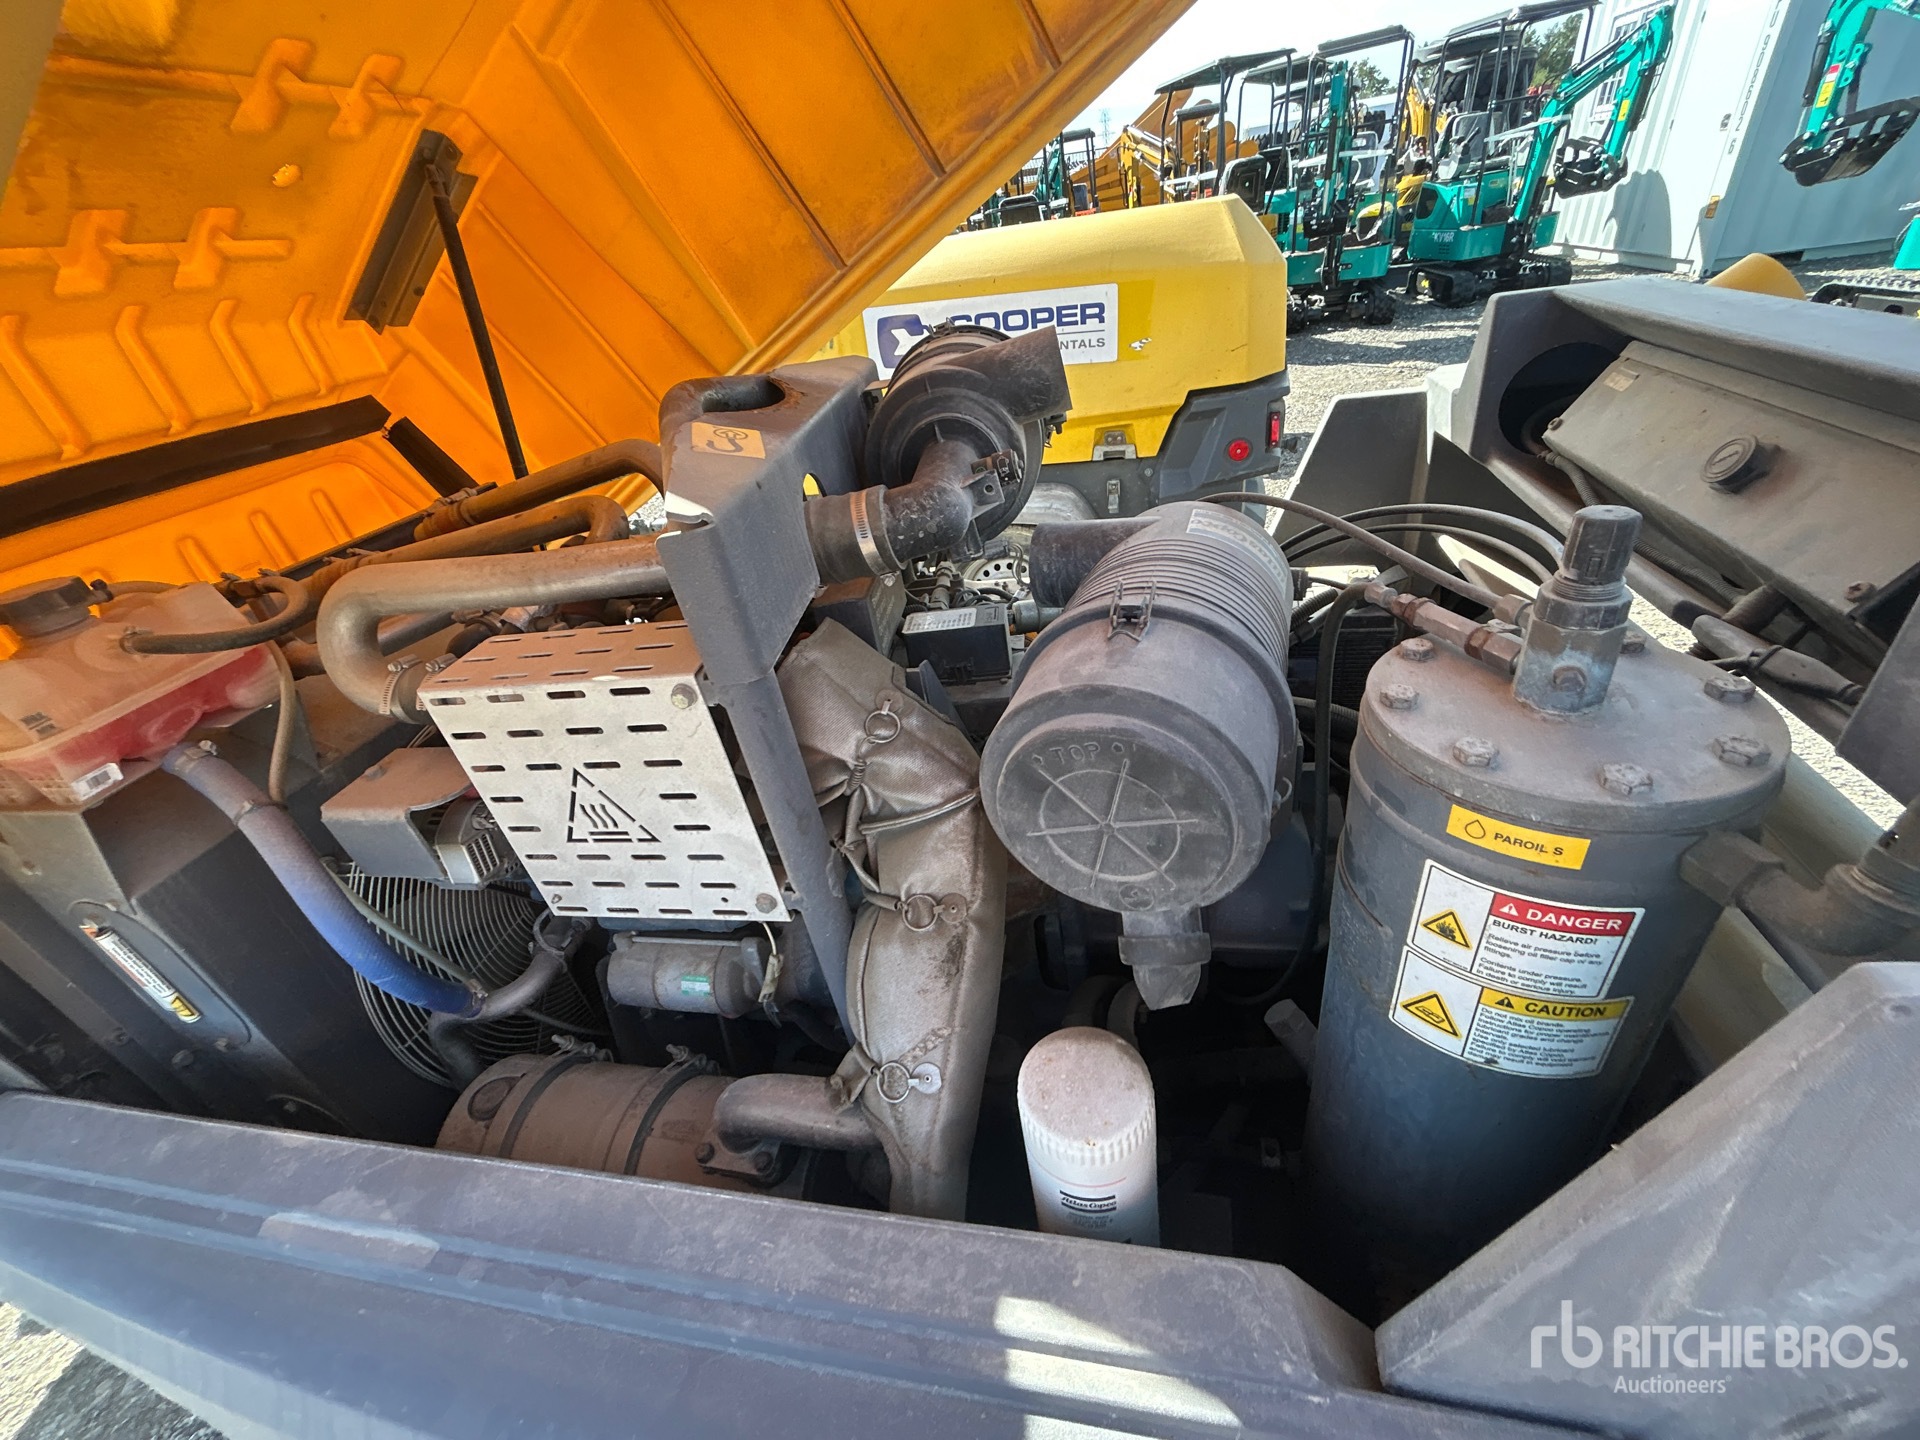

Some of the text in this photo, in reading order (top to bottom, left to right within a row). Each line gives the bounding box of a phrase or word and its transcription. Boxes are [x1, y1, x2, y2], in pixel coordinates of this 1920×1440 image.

[1060, 337, 1106, 351] NTALS
[1050, 741, 1101, 766] TOP
[1493, 832, 1564, 856] PAROIL S
[1525, 907, 1623, 931] DANGER
[1492, 919, 1598, 945] BURST HAZARD!
[1486, 940, 1525, 956] loosening
[1488, 933, 1519, 946] Relieve
[1533, 946, 1572, 957] pressure
[1573, 951, 1601, 959] before
[1478, 962, 1506, 976] Failure
[1517, 975, 1547, 985] comply
[1480, 957, 1516, 972] Contents
[1518, 968, 1543, 977] under
[1485, 971, 1508, 982] death
[1520, 982, 1550, 992] serious
[1480, 1013, 1505, 1023] Follow
[1481, 1007, 1493, 1015] Do
[1525, 1002, 1607, 1018] CAUTION
[1061, 1196, 1117, 1209] Atlas Copco
